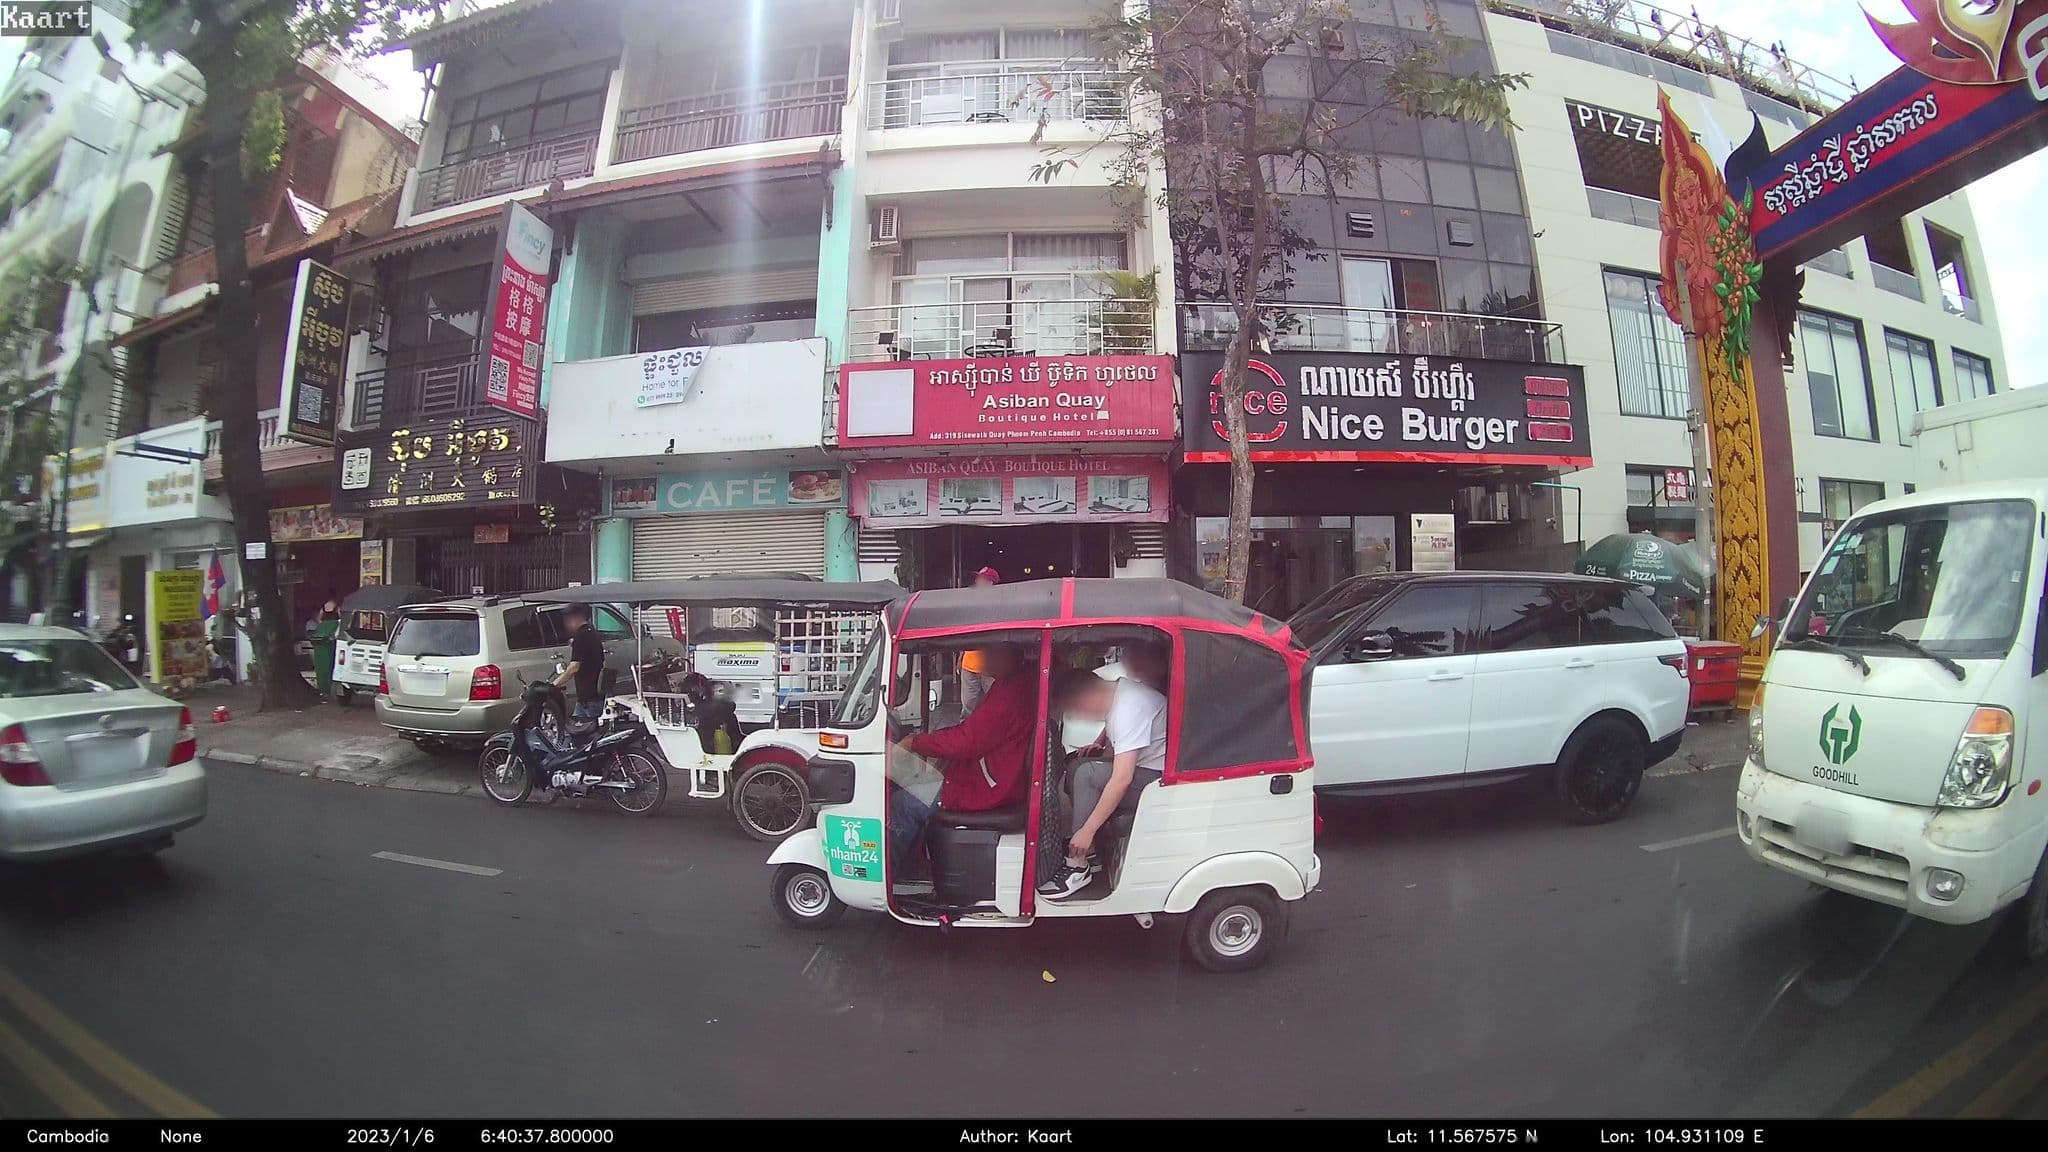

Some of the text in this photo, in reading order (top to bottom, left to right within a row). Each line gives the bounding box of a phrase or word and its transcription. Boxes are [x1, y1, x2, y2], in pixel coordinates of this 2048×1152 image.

[509, 286, 535, 316] 格格
[505, 307, 533, 337] 按摩
[982, 392, 1105, 409] Asiban Quay
[1209, 390, 1288, 415] nce
[978, 413, 1094, 423] Boutique Hotel
[1048, 429, 1081, 437] Cambodia
[1301, 405, 1520, 450] Nice Burger
[907, 459, 1110, 474] ASIBAN QUAY BOUTIQUE HOTEL
[667, 472, 777, 508] CAFÉ
[1586, 565, 1596, 575] 24
[1630, 569, 1656, 581] PIZZA
[717, 658, 759, 666] maxima
[1812, 765, 1859, 785] GOODHILL
[830, 846, 879, 864] nham24
